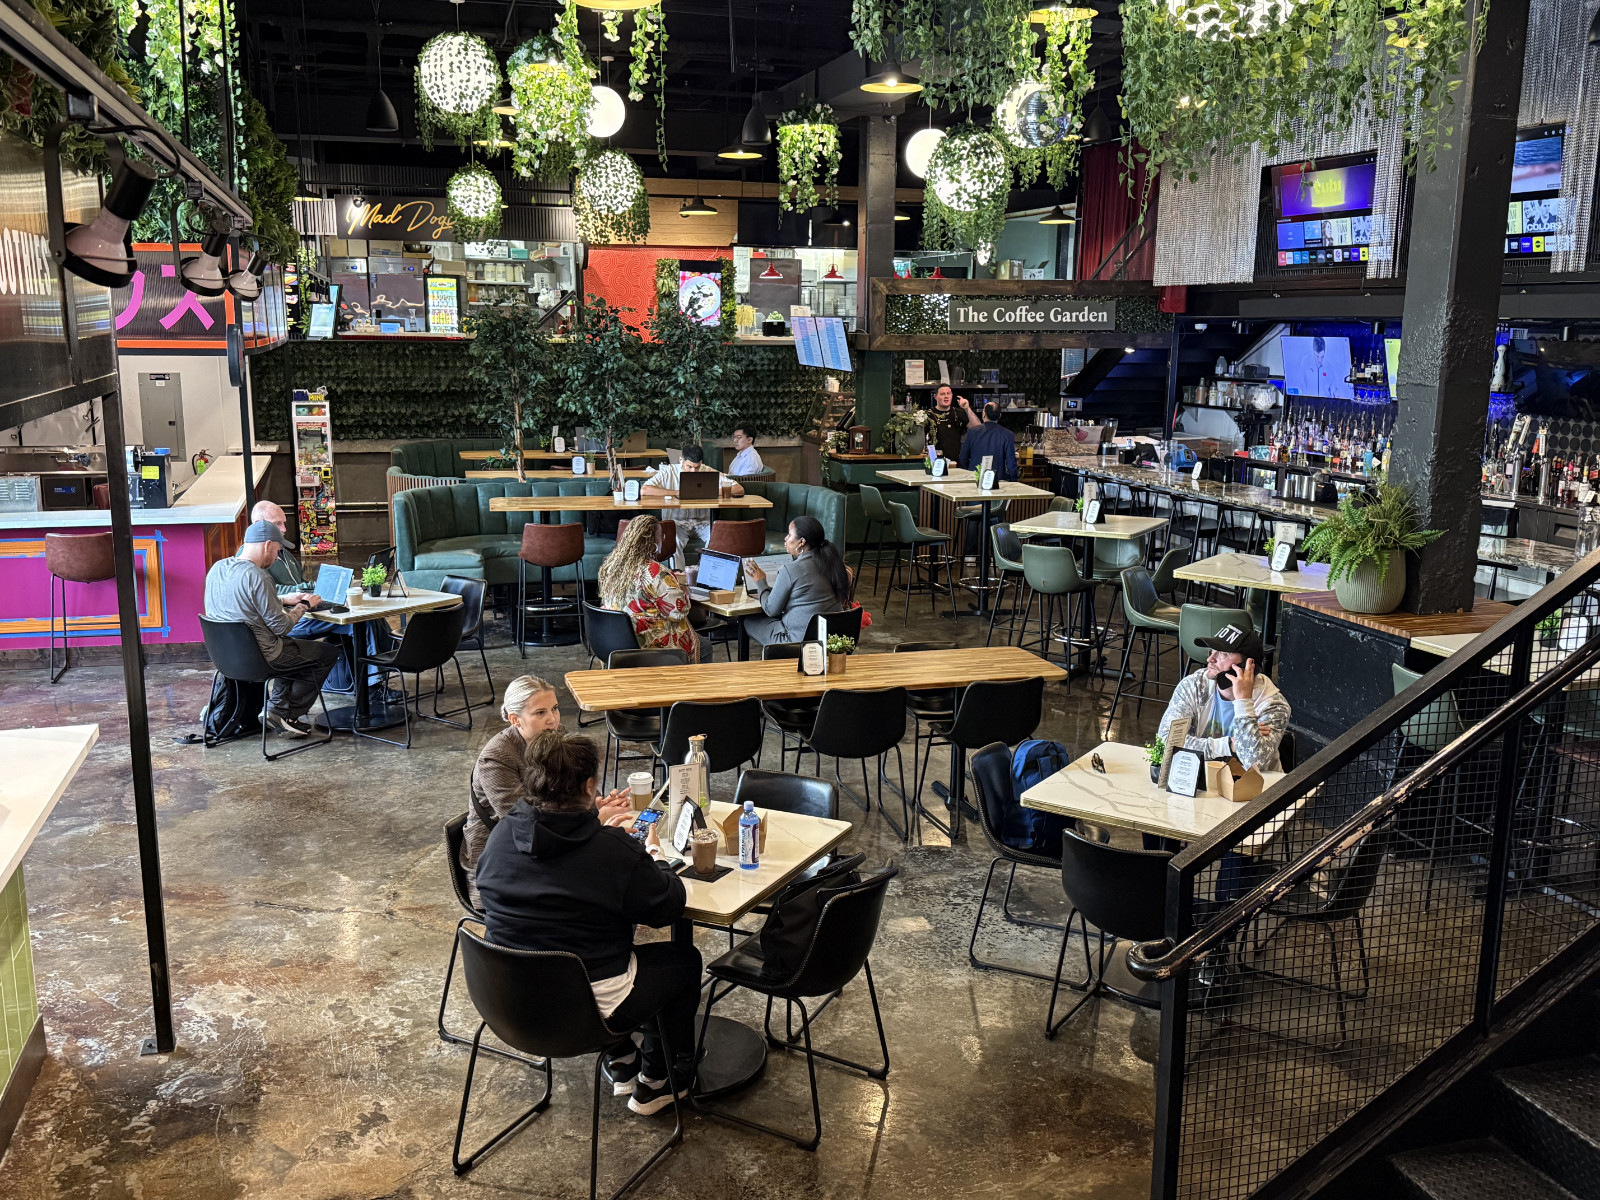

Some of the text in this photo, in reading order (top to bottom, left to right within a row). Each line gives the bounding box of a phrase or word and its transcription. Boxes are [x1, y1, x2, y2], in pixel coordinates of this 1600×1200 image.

[346, 202, 402, 235] Mad
[956, 305, 1108, 323] The Coffee Garden
